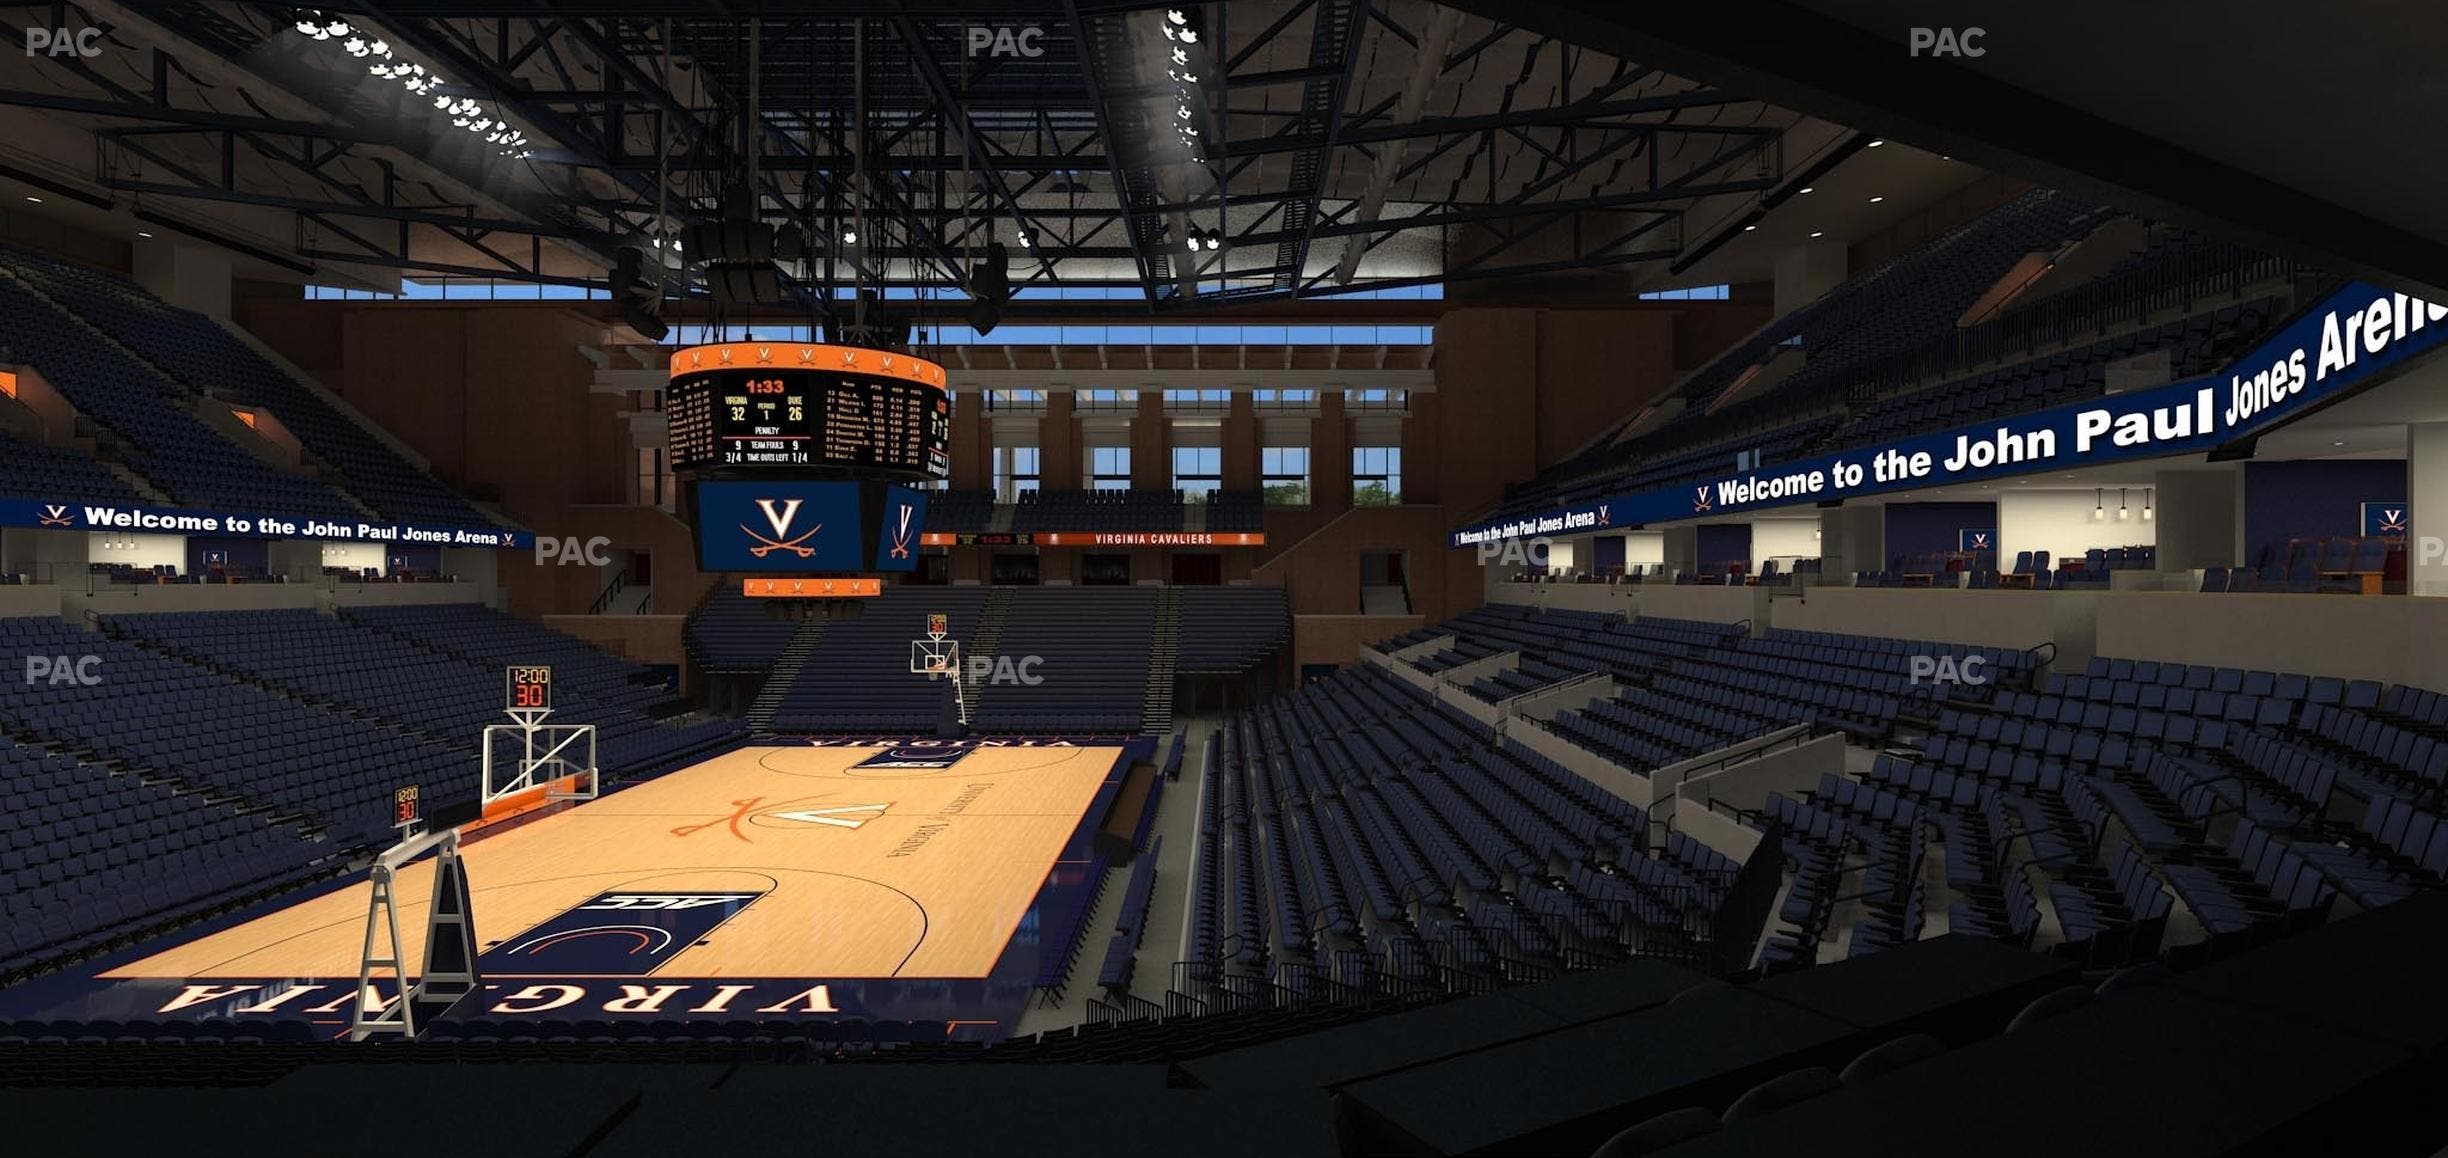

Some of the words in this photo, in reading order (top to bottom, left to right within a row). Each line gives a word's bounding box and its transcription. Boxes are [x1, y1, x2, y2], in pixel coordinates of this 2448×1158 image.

[746, 380, 784, 393] 1:33
[725, 396, 748, 404] VIRGINIA
[788, 396, 802, 405] DUKE
[732, 407, 745, 420] 32
[764, 410, 769, 420] 1
[788, 407, 802, 420] 26
[1718, 470, 1824, 506] Welcome
[1832, 460, 1864, 489] to
[1874, 449, 1932, 483] the
[1944, 428, 2055, 472] John
[2077, 388, 2213, 452] Paul
[2226, 348, 2306, 427] Jones
[736, 440, 741, 450] 9
[751, 441, 766, 449] TEAM
[766, 441, 784, 449] FOULS
[792, 440, 798, 450] 9
[725, 452, 742, 463] 3/4
[747, 453, 760, 462] TIME
[760, 453, 775, 462] OUTS
[776, 453, 788, 462] LEFT
[792, 452, 808, 463] 1/4
[84, 507, 218, 531] Welcome
[226, 516, 251, 532] to
[258, 518, 296, 534] the
[302, 520, 351, 537] John
[358, 524, 398, 540] Paul
[402, 528, 450, 542] Jones
[455, 530, 498, 544] Arena
[755, 500, 804, 540] V
[1460, 532, 1482, 544] Welcome
[1491, 526, 1500, 540] the
[1502, 524, 1518, 538] John
[1520, 518, 1536, 536] Paul
[1538, 517, 1562, 533] Jones
[1565, 512, 1595, 528] Arena
[1096, 534, 1146, 544] VIRGINIA
[1151, 534, 1212, 544] CAVALIERS
[515, 669, 548, 684] 12:00
[517, 685, 542, 706] 30
[398, 788, 417, 802] 12:00
[400, 802, 414, 820] 30
[156, 984, 839, 1013] VIRGNIA
